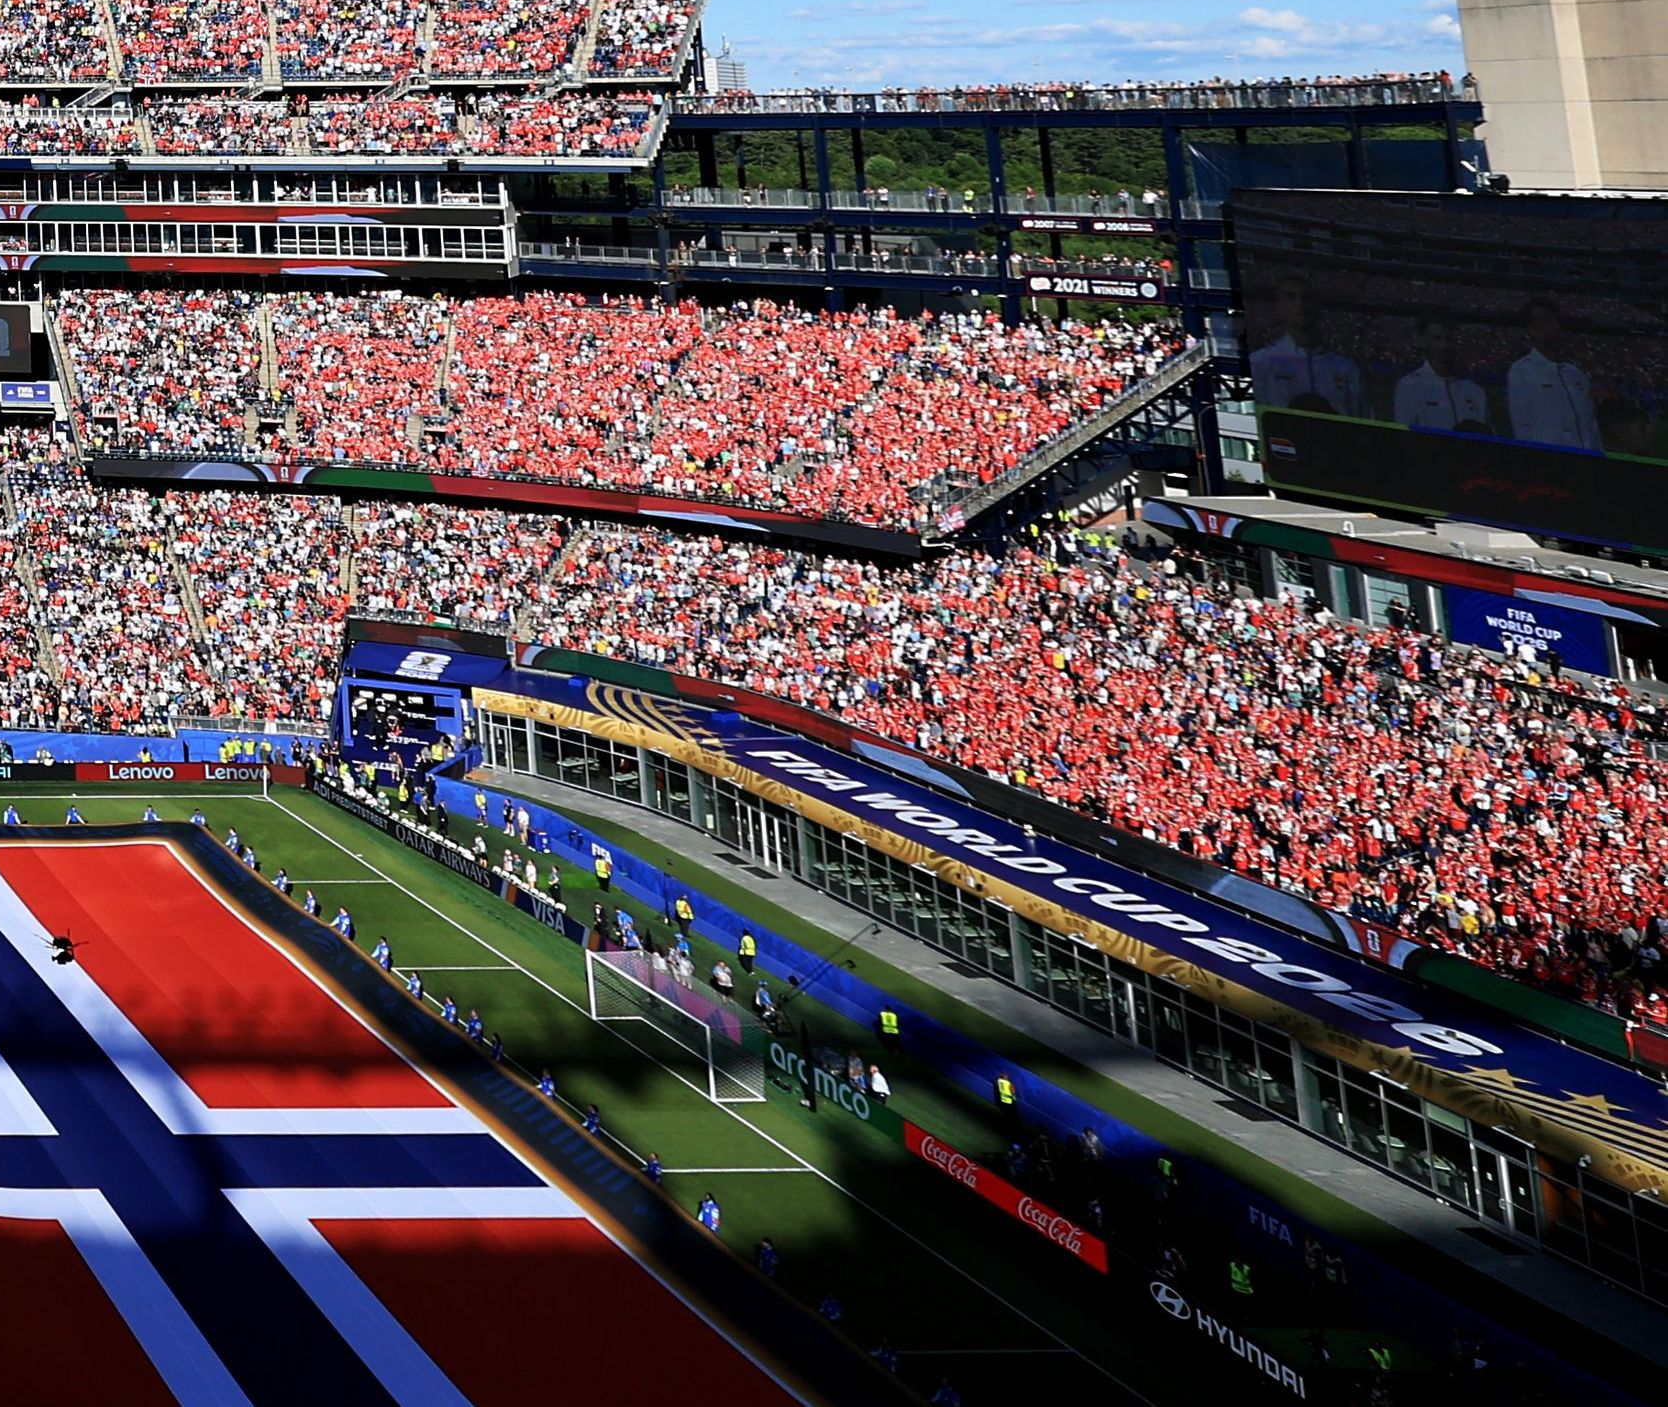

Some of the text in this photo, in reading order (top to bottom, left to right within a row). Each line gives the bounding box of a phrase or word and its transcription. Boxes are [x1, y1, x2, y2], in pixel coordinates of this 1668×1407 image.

[1053, 277, 1089, 294] 2021
[1091, 286, 1138, 297] WINNERS
[1485, 615, 1563, 642] WORLD CUP
[1506, 608, 1537, 624] FIFA
[108, 763, 175, 780] Lenovo
[204, 763, 271, 781] Lenovo
[313, 780, 389, 831] ADI PREDICTSTREET
[395, 823, 492, 889] QATAR AIRWAYS
[531, 896, 566, 936] VISA
[745, 750, 869, 793] FIFA
[850, 792, 1068, 875] WORLD
[1053, 876, 1211, 935] CUP
[1181, 936, 1505, 1057] 2026
[1247, 1205, 1294, 1247] FIFA
[1196, 1308, 1307, 1400] HYUNDAI
